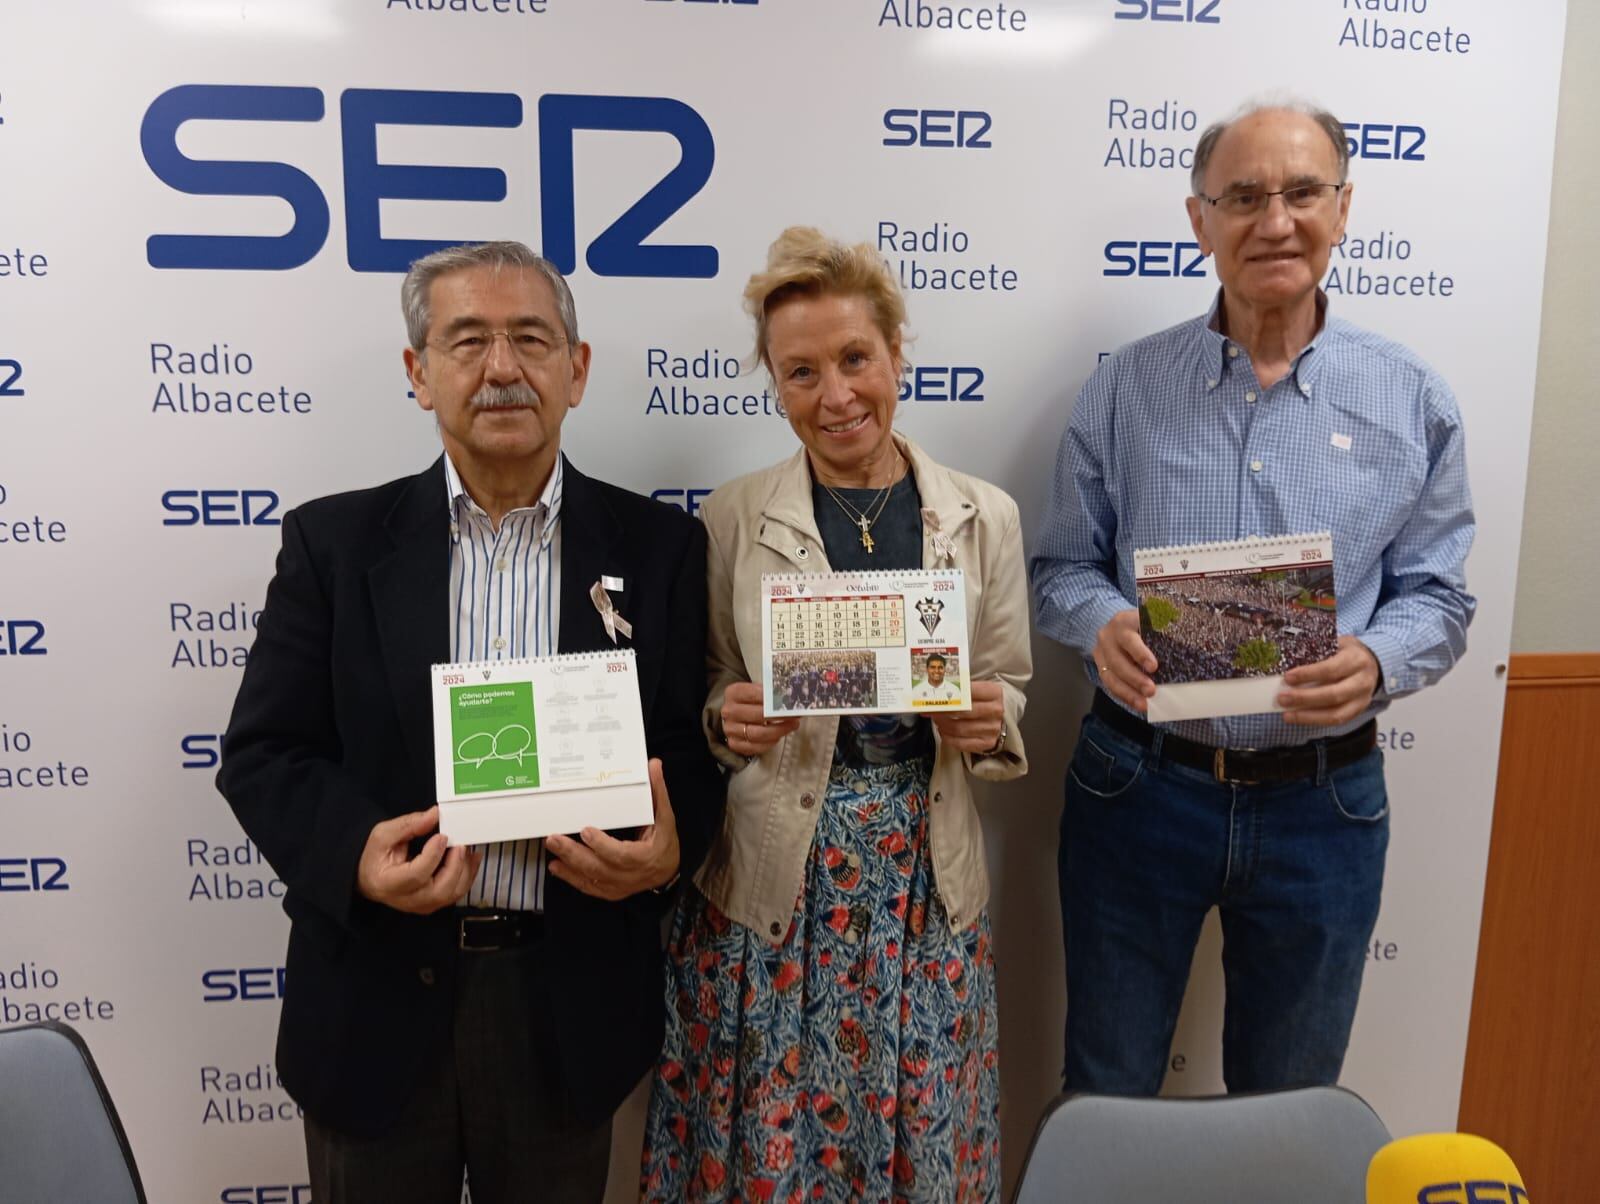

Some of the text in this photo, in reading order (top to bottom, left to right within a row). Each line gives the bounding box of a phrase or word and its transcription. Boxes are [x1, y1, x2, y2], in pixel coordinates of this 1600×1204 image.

[879, 0, 1026, 31] Albacete
[1339, 18, 1471, 53] Albacete
[883, 109, 992, 148] SER
[1108, 99, 1197, 131] Radio
[1104, 138, 1194, 168] Albac
[140, 84, 719, 278] SER
[878, 222, 969, 253] Radio
[1103, 241, 1207, 277] SER
[1324, 266, 1454, 297] Albacete
[151, 344, 253, 375] Radio
[647, 348, 740, 379] Radio
[152, 383, 312, 414] Albacete
[162, 490, 281, 525] SER
[771, 587, 792, 596] 2024
[933, 583, 955, 592] 2024
[777, 632, 785, 640] 21
[442, 675, 465, 685] 2024
[607, 663, 628, 673] 2024
[459, 698, 493, 707] ayudarte?
[483, 690, 515, 699] podemos
[189, 873, 288, 901] Albac
